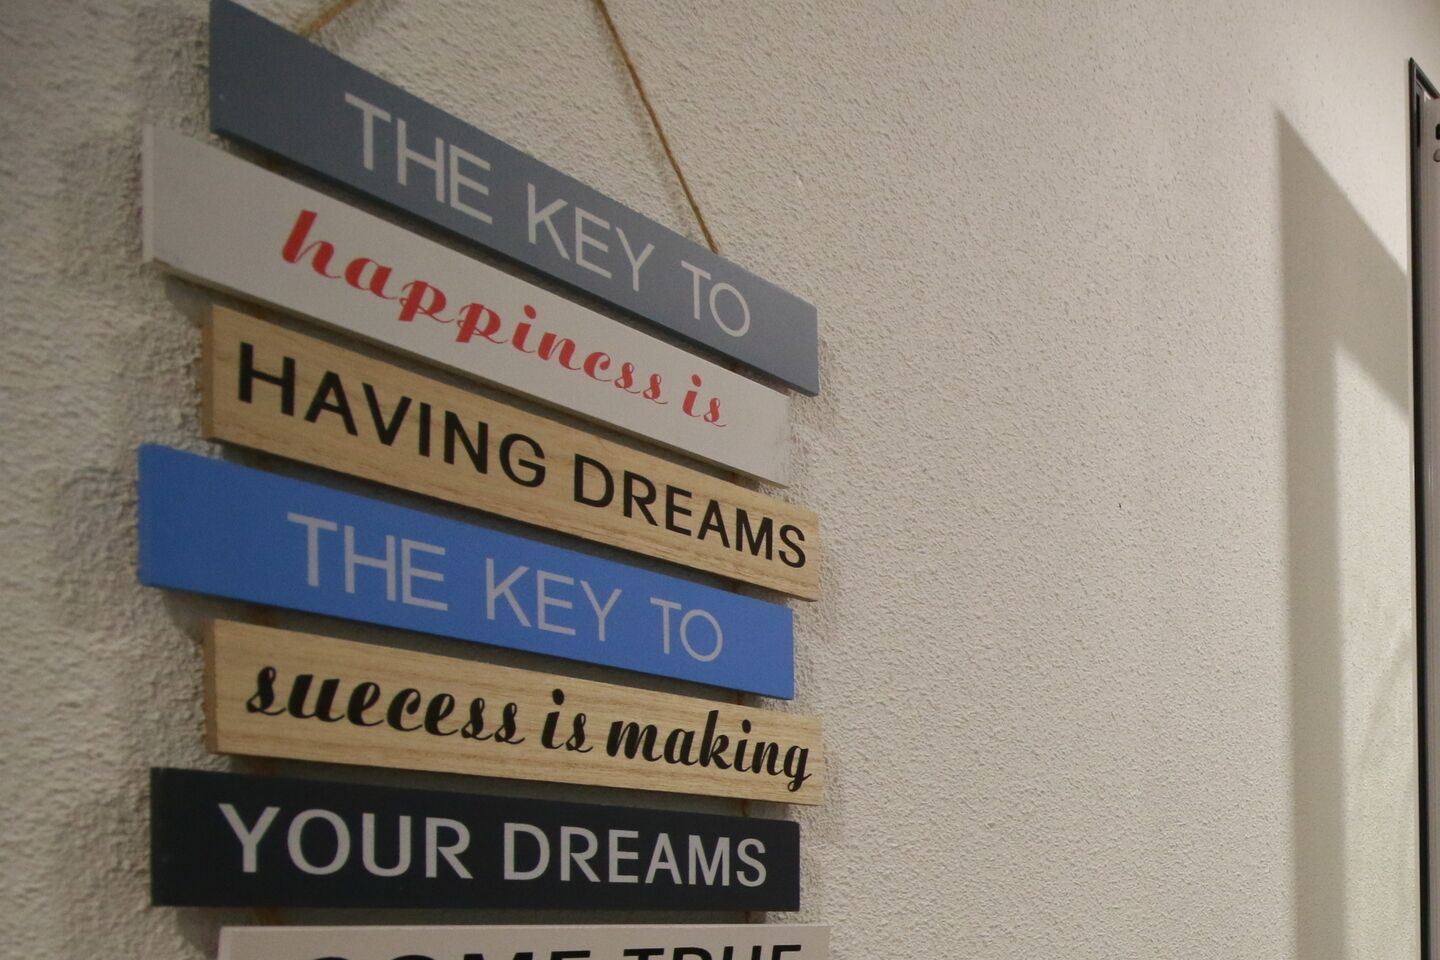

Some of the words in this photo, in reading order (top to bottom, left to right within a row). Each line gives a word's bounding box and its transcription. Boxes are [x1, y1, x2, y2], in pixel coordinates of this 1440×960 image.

[344, 92, 493, 225] THE
[527, 183, 655, 292] KEY
[681, 260, 751, 338] TO
[238, 342, 546, 488] HAVING
[573, 456, 807, 569] DREAMS
[682, 374, 727, 428] is
[287, 512, 448, 611] THE
[486, 558, 622, 642] KEY
[650, 598, 724, 662] TO
[541, 689, 594, 753] is
[606, 710, 812, 792] making
[218, 803, 474, 880] YOUR
[503, 822, 767, 888] DREAMS
